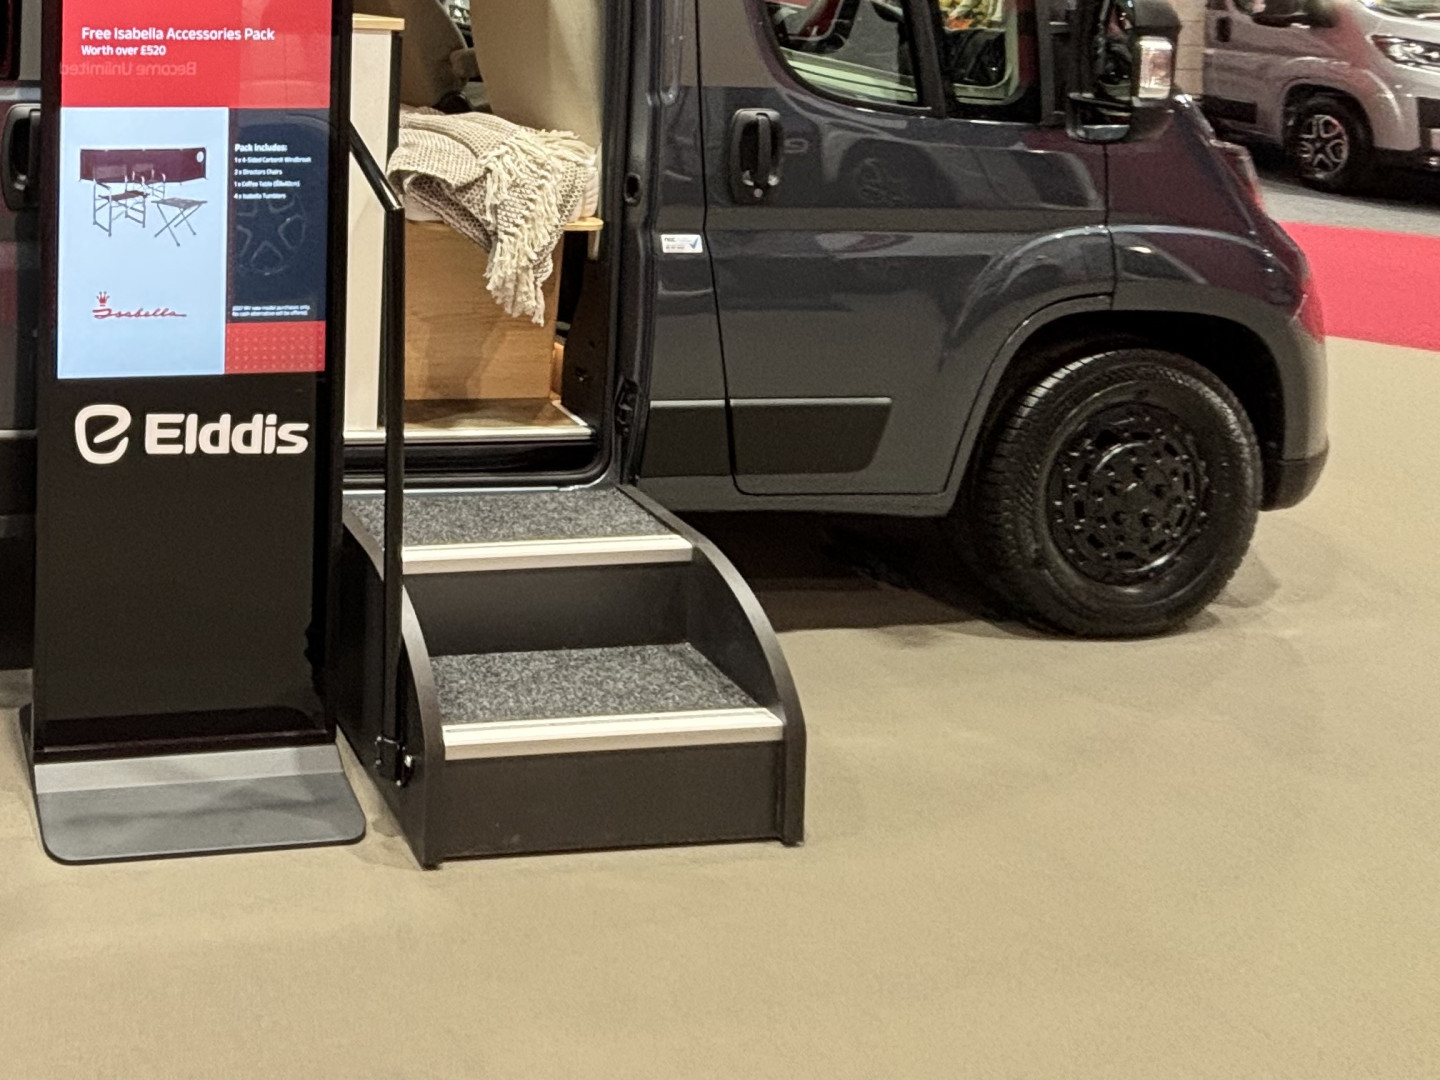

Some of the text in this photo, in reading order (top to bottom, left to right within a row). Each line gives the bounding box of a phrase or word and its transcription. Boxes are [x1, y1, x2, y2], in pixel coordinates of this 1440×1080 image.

[81, 27, 275, 40] Free Isabella Accessories Pack
[81, 45, 166, 56] Worth over £520
[234, 143, 253, 152] Pack
[92, 308, 187, 319] Isabella
[145, 413, 309, 455] Elddis
